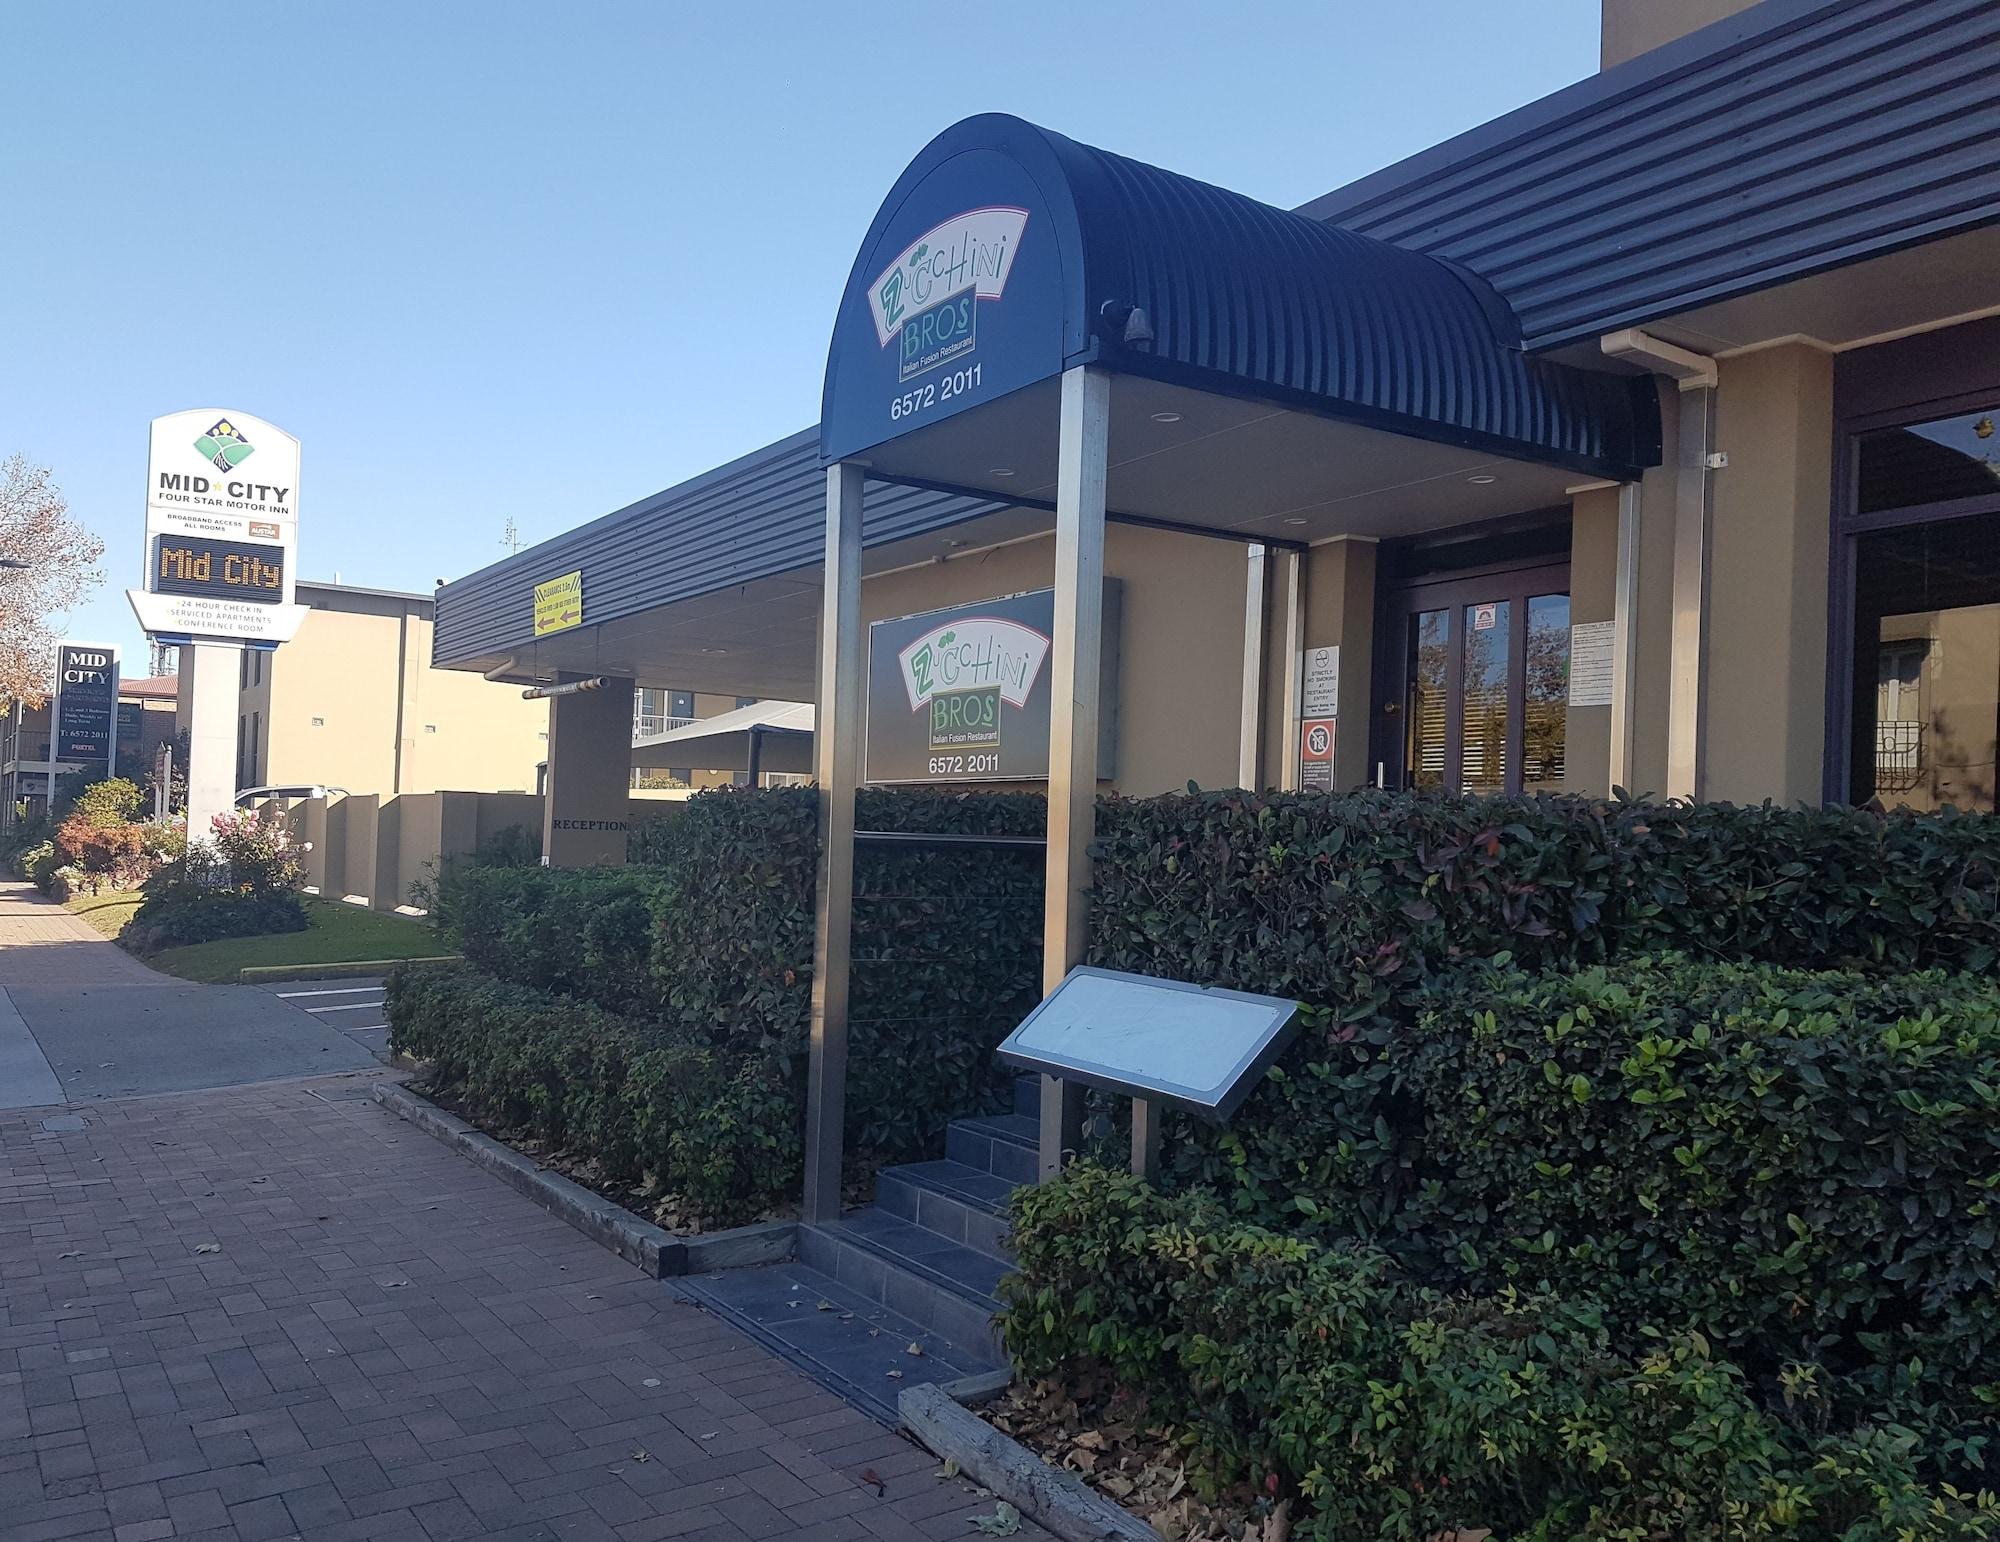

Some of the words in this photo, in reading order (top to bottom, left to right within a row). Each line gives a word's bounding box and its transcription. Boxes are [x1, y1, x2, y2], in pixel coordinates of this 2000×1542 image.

[903, 298, 970, 359] BROS
[902, 361, 920, 374] Italian
[920, 352, 940, 367] Fusion
[940, 335, 973, 357] Restaurant
[890, 383, 936, 421] 6572
[940, 362, 982, 401] 2011
[160, 472, 210, 493] MID
[227, 481, 289, 503] CITY
[159, 492, 190, 503] FOUR
[193, 496, 223, 506] STAR
[226, 500, 266, 512] MOTOR
[269, 505, 289, 514] INN
[167, 513, 213, 524] BROADBAND
[214, 519, 243, 527] ACCESS
[199, 524, 226, 532] ROOMS
[161, 547, 211, 581] Mid
[224, 554, 280, 588] City
[181, 600, 192, 608] 24
[195, 601, 220, 610] HOUR
[170, 609, 213, 619] SERVICED
[216, 613, 272, 624] APARTMENTS
[178, 619, 233, 630] CONFERENCE
[238, 624, 264, 632] ROOM
[70, 652, 107, 667] MID
[64, 669, 110, 685] CITY
[1311, 669, 1333, 677] STRICTLY
[932, 694, 995, 732] BROS
[60, 729, 68, 737] T:
[70, 730, 89, 738] 6572
[91, 731, 108, 739] 2011
[932, 735, 948, 744] Italian
[948, 733, 967, 743] Fusion
[967, 731, 997, 741] Restaurant
[928, 755, 963, 774] 6572
[967, 754, 999, 772] 2011
[553, 819, 627, 832] RECEPTION
